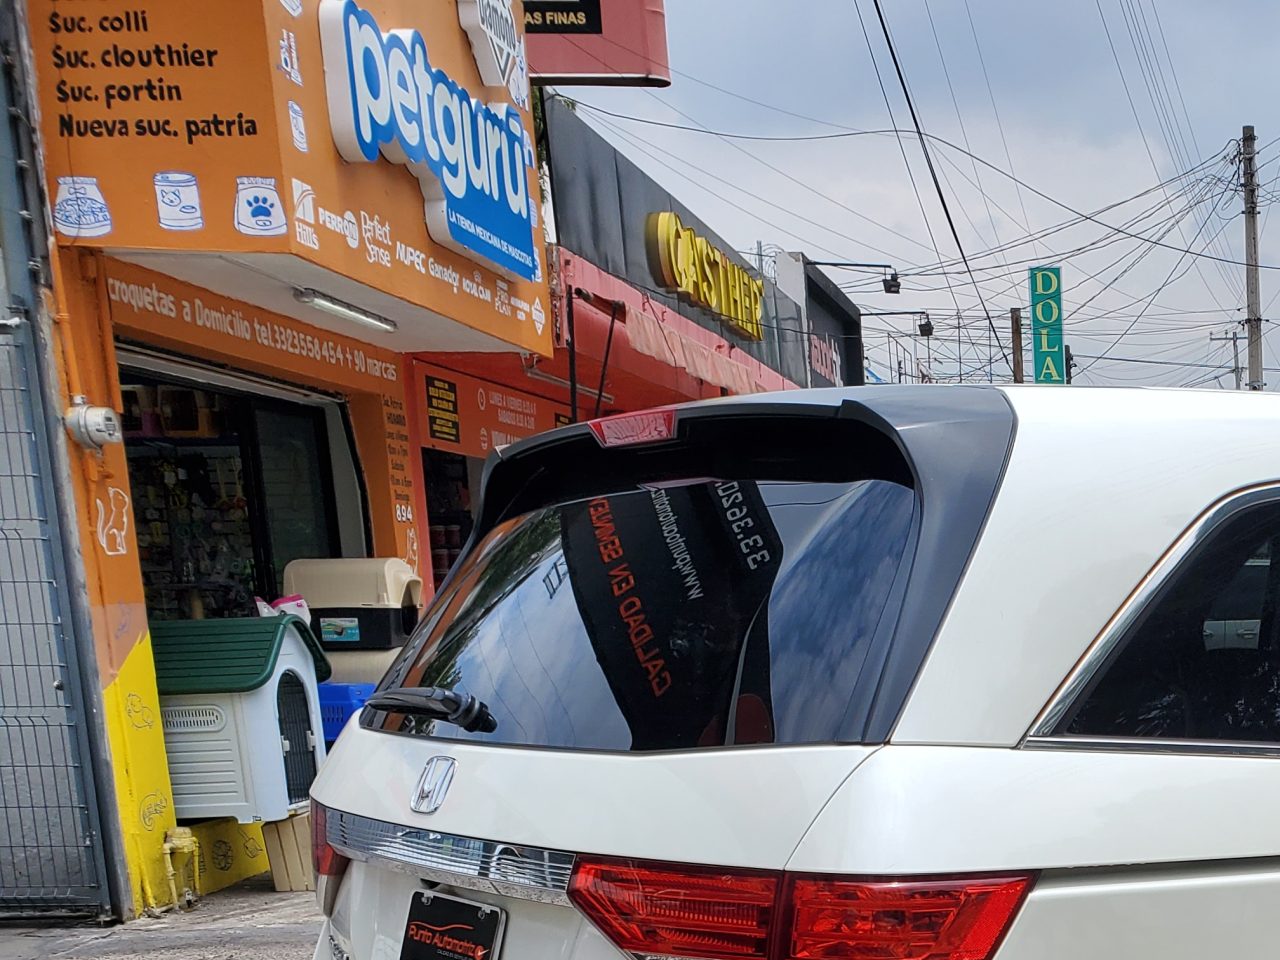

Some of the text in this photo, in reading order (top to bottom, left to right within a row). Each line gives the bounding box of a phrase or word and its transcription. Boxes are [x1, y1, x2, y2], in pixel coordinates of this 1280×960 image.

[49, 10, 149, 34] Suc. colli
[545, 12, 586, 25] FINAS
[52, 43, 218, 69] Suc. clouthier
[56, 77, 182, 109] Suc. fortin
[58, 113, 130, 138] Nueva
[136, 119, 180, 138] suc.
[108, 277, 177, 318] croquetas
[182, 300, 192, 323] a
[194, 298, 252, 341] Domicilio
[395, 503, 414, 524] 894
[408, 925, 433, 945] Punto
